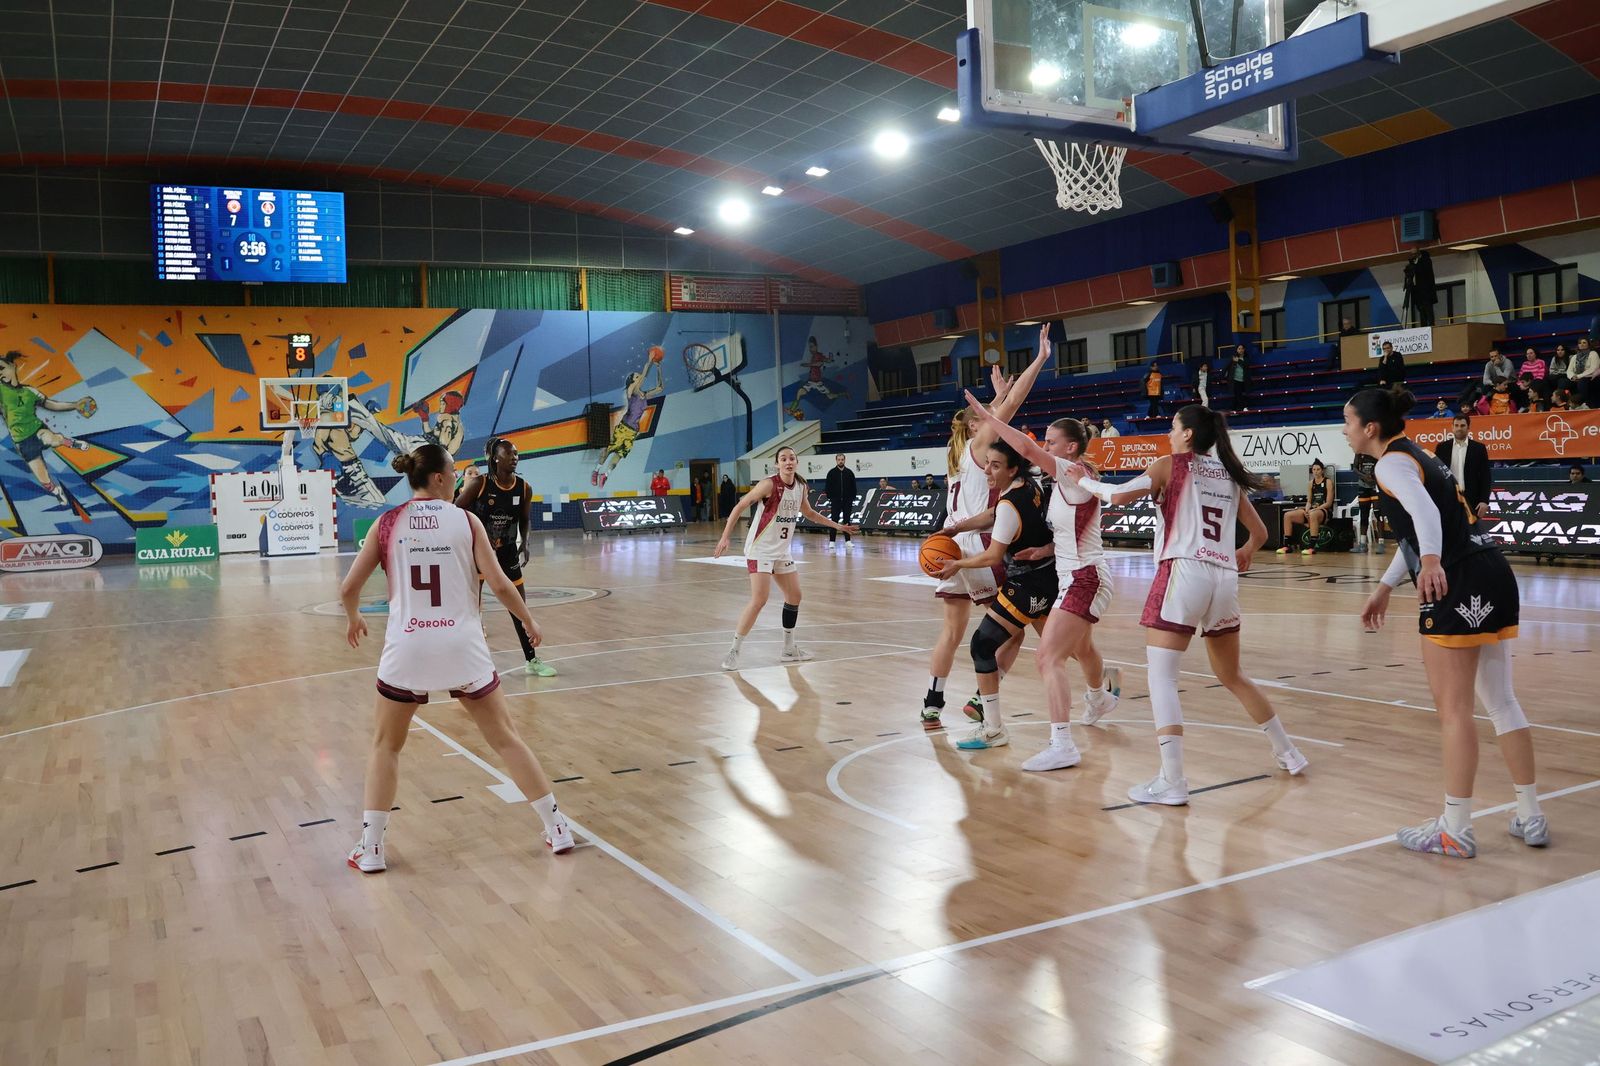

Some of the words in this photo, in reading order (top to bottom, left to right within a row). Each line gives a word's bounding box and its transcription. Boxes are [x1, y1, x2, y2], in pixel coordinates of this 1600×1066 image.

[1204, 51, 1274, 86] Schelde
[1205, 65, 1274, 100] Sports
[229, 214, 237, 227] 7
[239, 241, 267, 256] 3:56
[274, 260, 281, 270] 2
[295, 347, 306, 361] 8
[1478, 425, 1513, 441] salud
[1241, 432, 1323, 457] ZAMORA
[242, 480, 257, 497] La
[950, 481, 961, 512] 7
[277, 510, 315, 519] cobreros
[410, 515, 439, 529] NINA
[1202, 505, 1223, 542] 5
[780, 527, 789, 540] 3
[7, 542, 84, 561] AMAQ
[138, 548, 170, 560] CAJA
[170, 546, 215, 558] RURAL
[410, 564, 442, 607] 4
[408, 617, 455, 630] LOGROÑO
